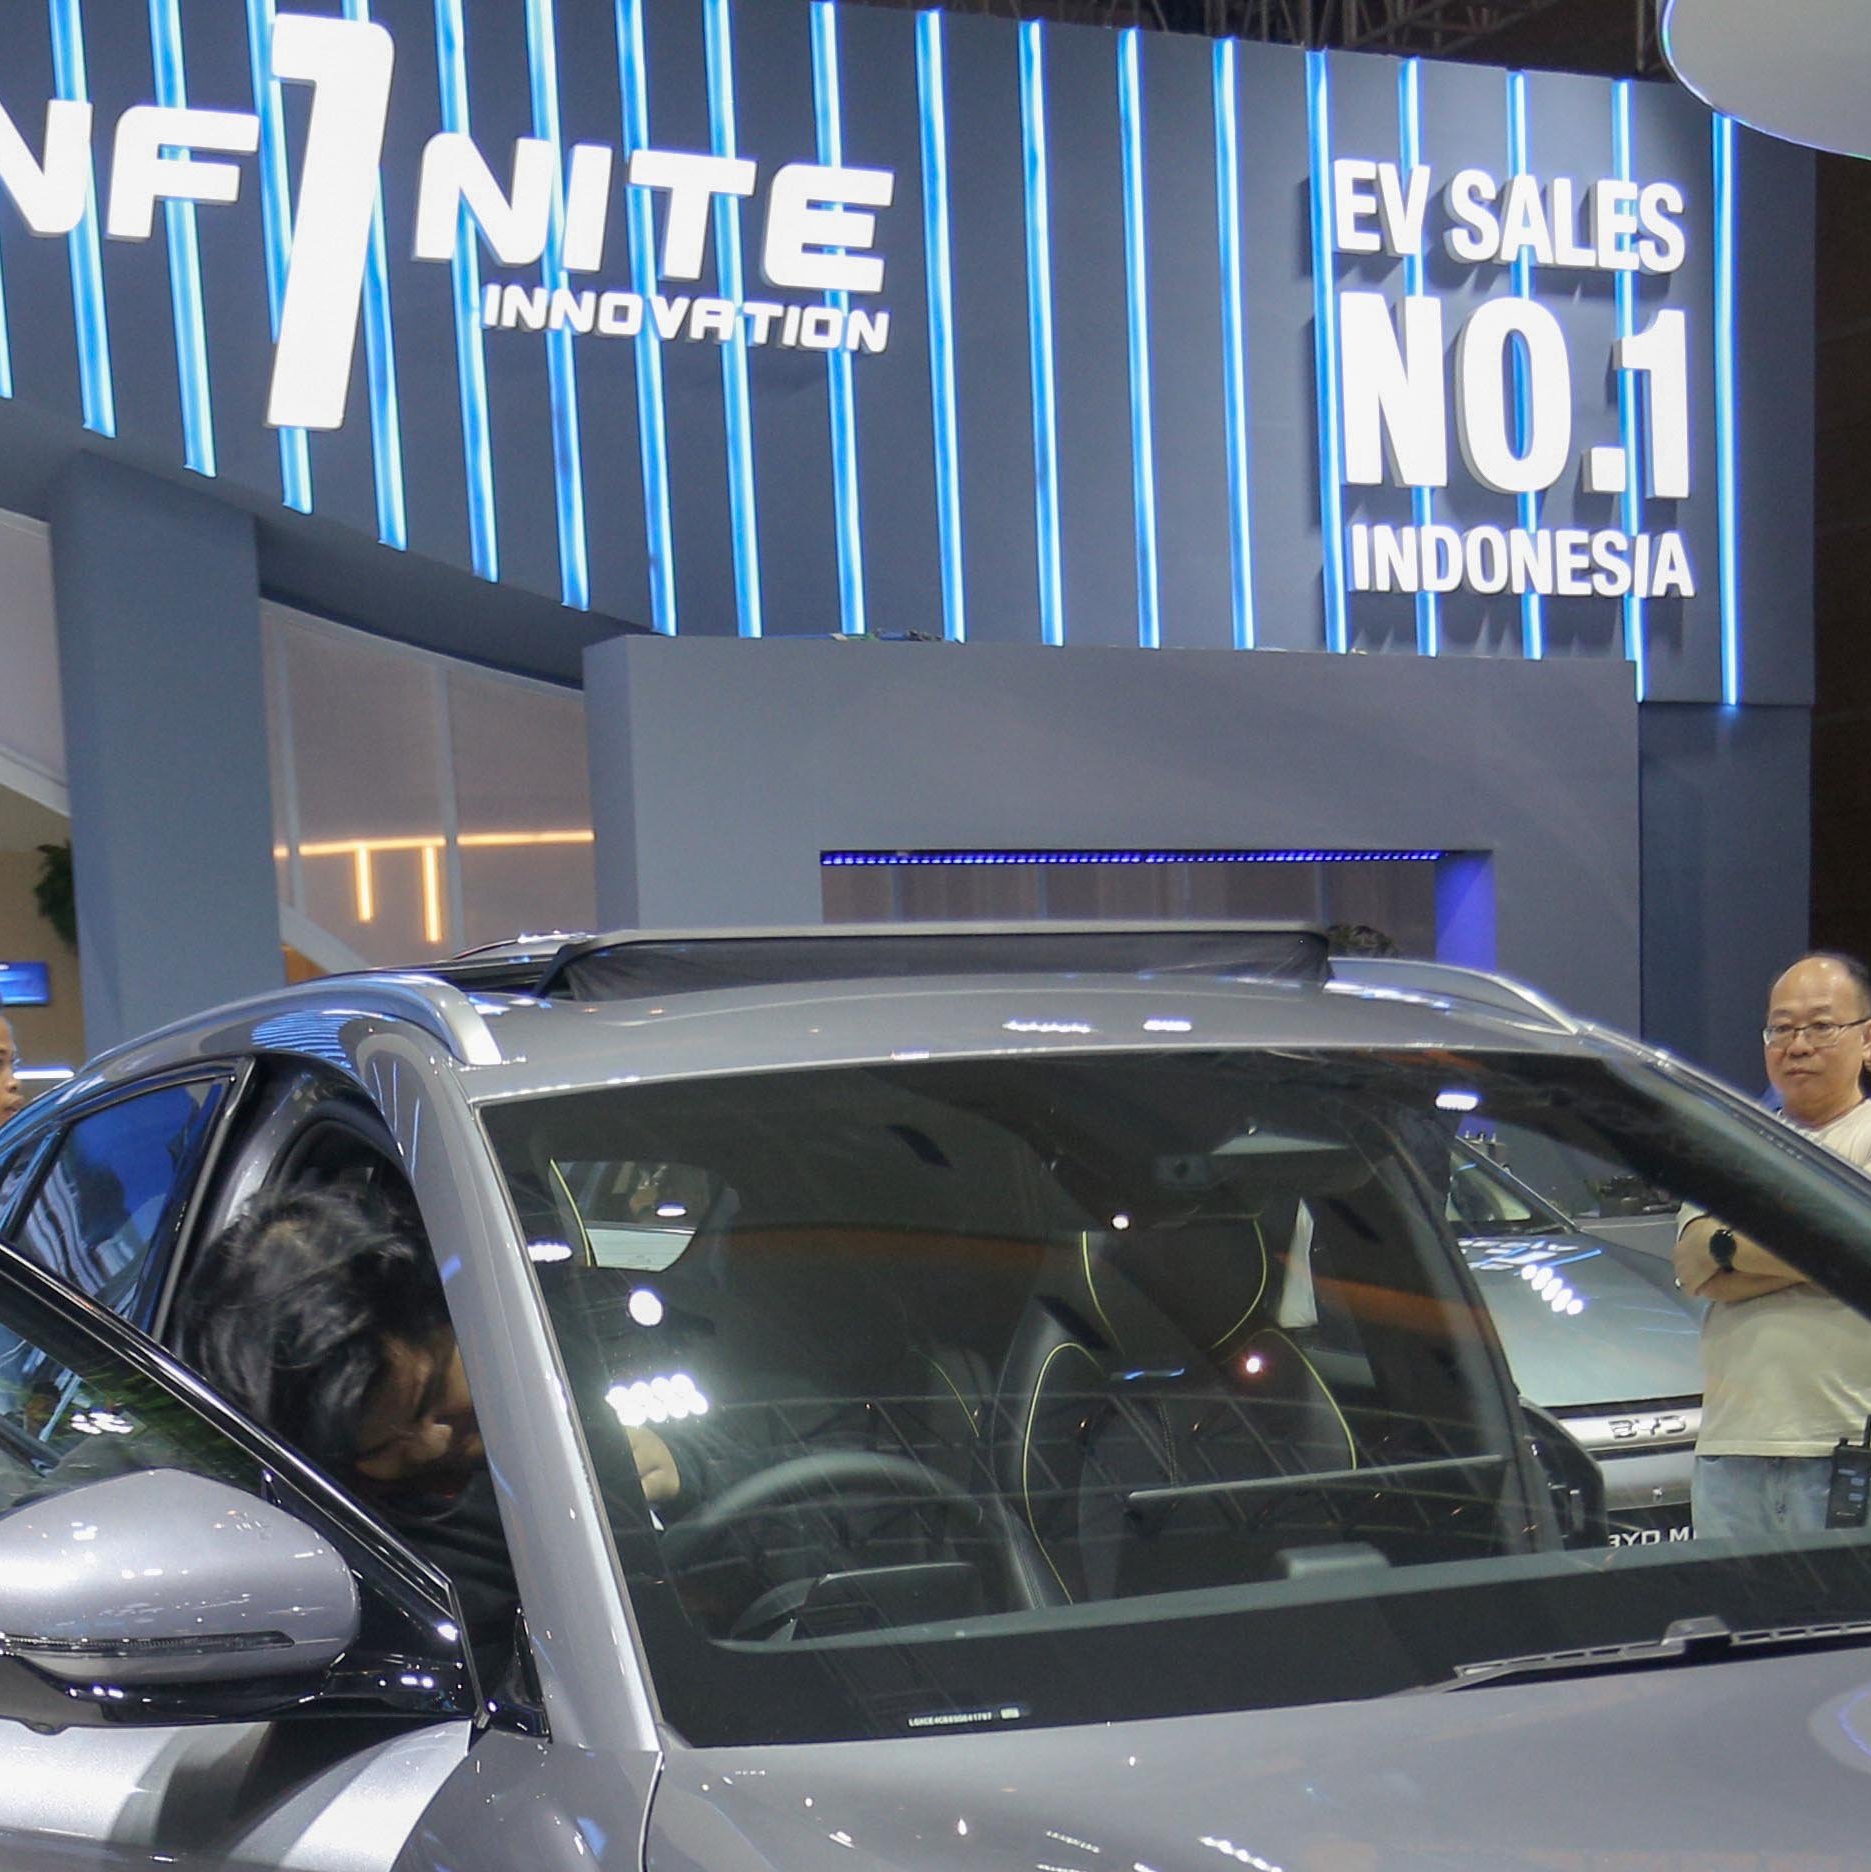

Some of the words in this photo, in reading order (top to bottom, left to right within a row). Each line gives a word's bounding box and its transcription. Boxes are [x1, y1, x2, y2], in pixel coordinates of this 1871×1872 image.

[1333, 159, 1431, 257] EV
[1445, 169, 1687, 273] SALES
[483, 284, 891, 353] INNOVATION
[1339, 291, 1691, 499] NO.1
[1351, 524, 1697, 599] INDONESIA
[1608, 1415, 1687, 1440] BYD
